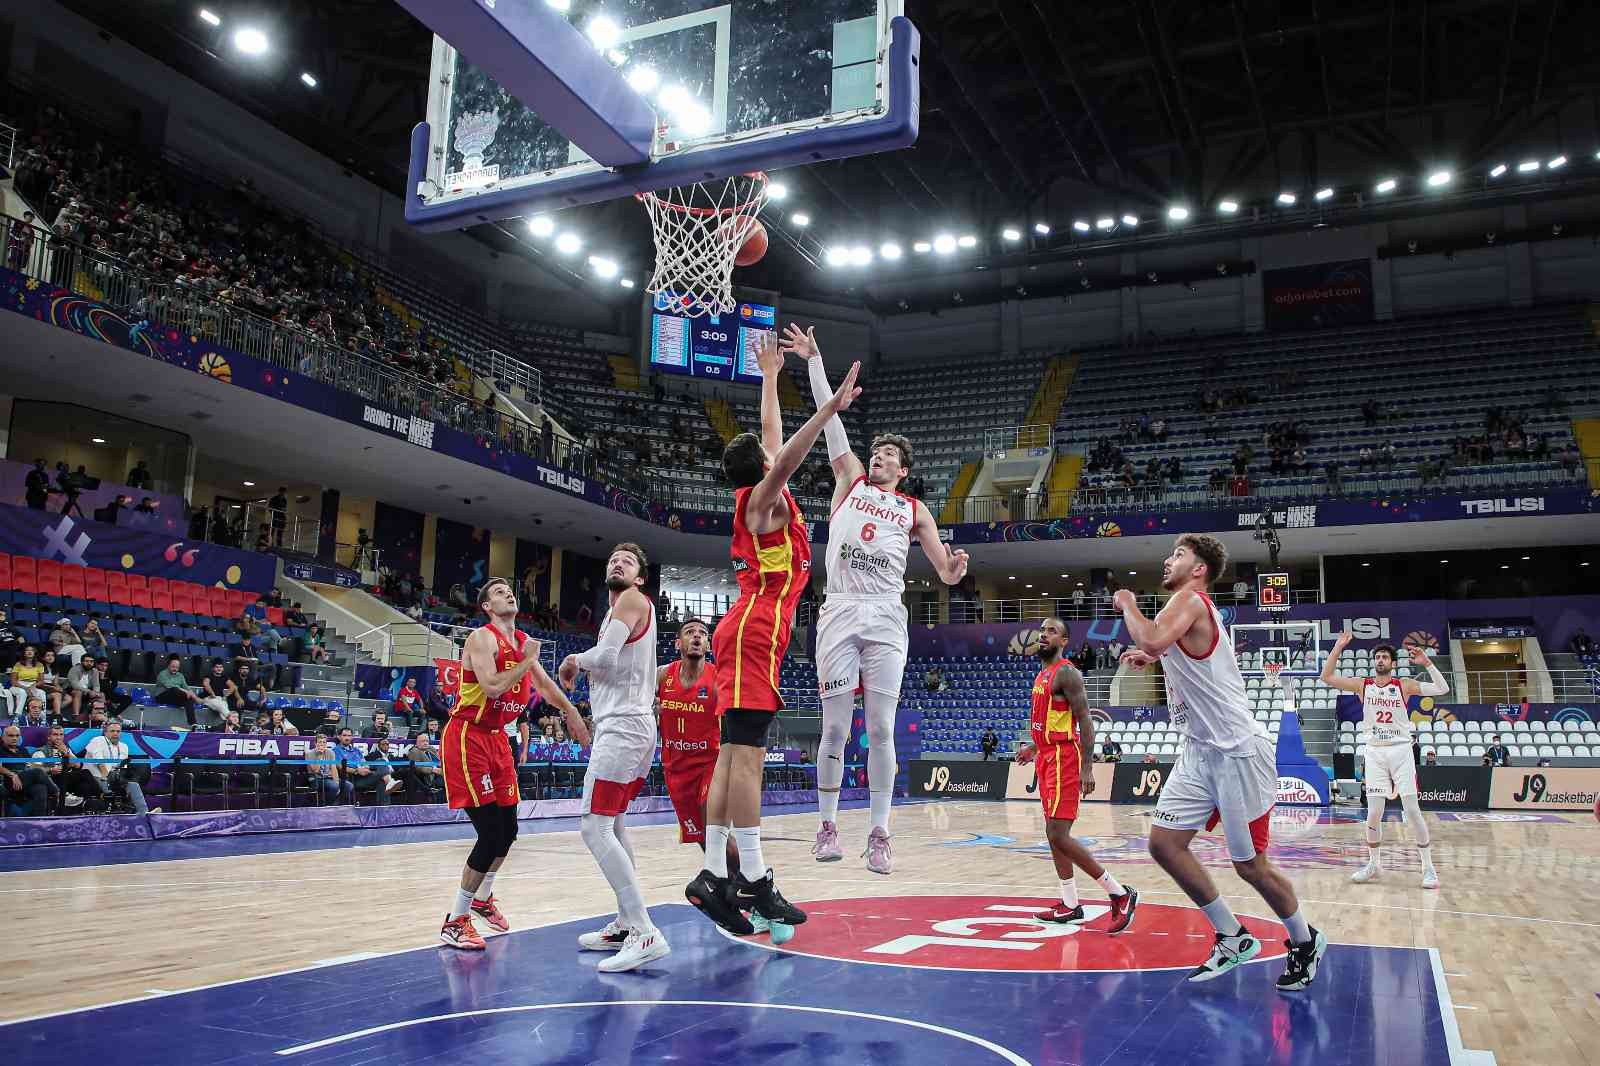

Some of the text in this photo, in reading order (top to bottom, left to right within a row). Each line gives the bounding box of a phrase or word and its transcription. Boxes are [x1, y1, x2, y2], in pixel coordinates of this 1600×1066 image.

[753, 309, 774, 319] ESP
[701, 330, 728, 342] 3:09
[364, 405, 435, 449] BRING THE NOISE
[536, 465, 585, 495] TBILISI
[849, 496, 908, 528] TÜRKİYE
[1460, 497, 1545, 514] TBILISI
[1286, 505, 1317, 528] NOISE
[861, 522, 877, 542] 6
[851, 547, 890, 569] Garanti
[850, 560, 878, 574] BBVA
[1266, 576, 1287, 586] 3:09
[1260, 616, 1391, 641] TBILISI
[660, 699, 705, 713] ESPAÑA
[677, 717, 685, 734] 11
[1376, 711, 1393, 724] 22
[218, 738, 281, 756] FIBA
[666, 738, 708, 751] endesa
[1275, 790, 1317, 802] anten
